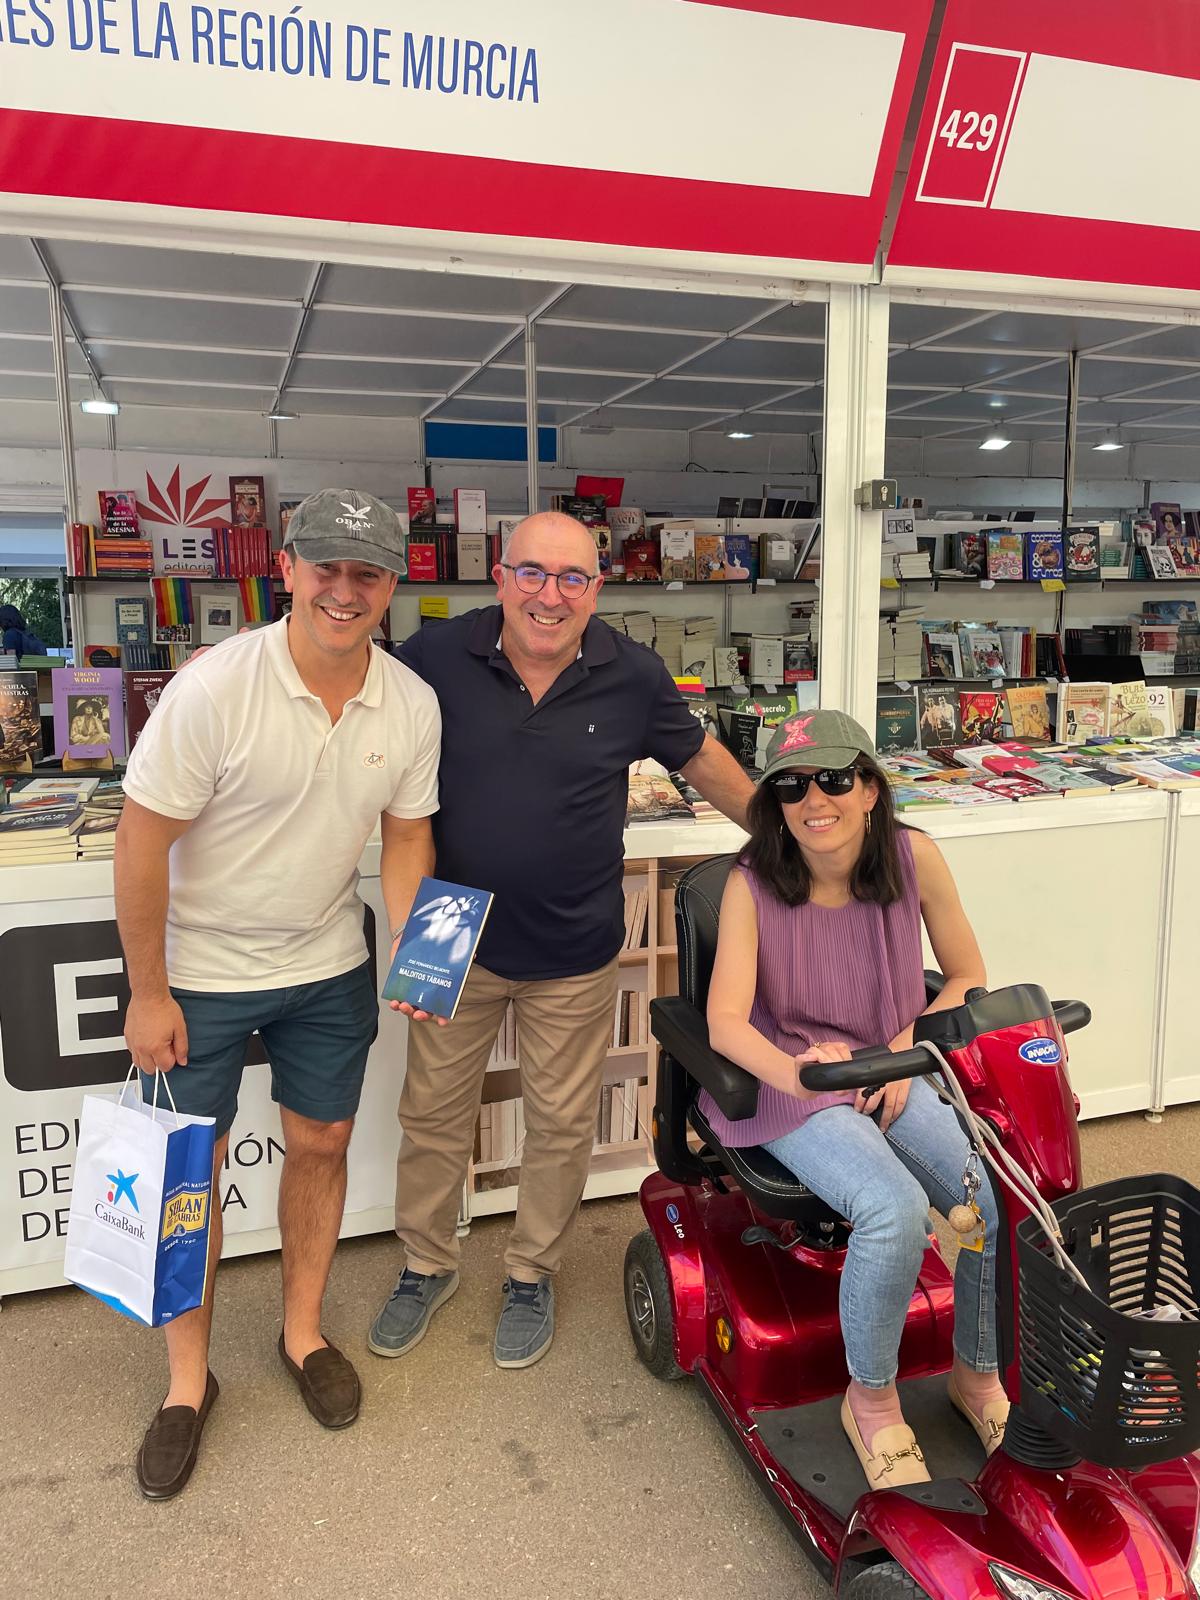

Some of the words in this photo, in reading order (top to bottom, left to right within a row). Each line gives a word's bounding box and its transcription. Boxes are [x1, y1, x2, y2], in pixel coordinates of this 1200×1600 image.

[0, 0, 54, 48] ES
[68, 0, 119, 54] DE
[131, 0, 179, 61] LA
[192, 5, 331, 78] REGIÓN
[346, 25, 391, 86] DE
[403, 32, 540, 103] MURCIA
[940, 109, 998, 151] 429
[106, 526, 136, 534] ASESINA
[162, 538, 216, 559] LES
[164, 562, 215, 573] editoria
[1121, 684, 1145, 694] BLAS
[1147, 694, 1165, 705] 92
[398, 967, 426, 981] MALDITOS
[426, 975, 452, 988] TÁBANOS
[94, 1203, 146, 1240] CaixaBank
[673, 1224, 685, 1239] Leo
